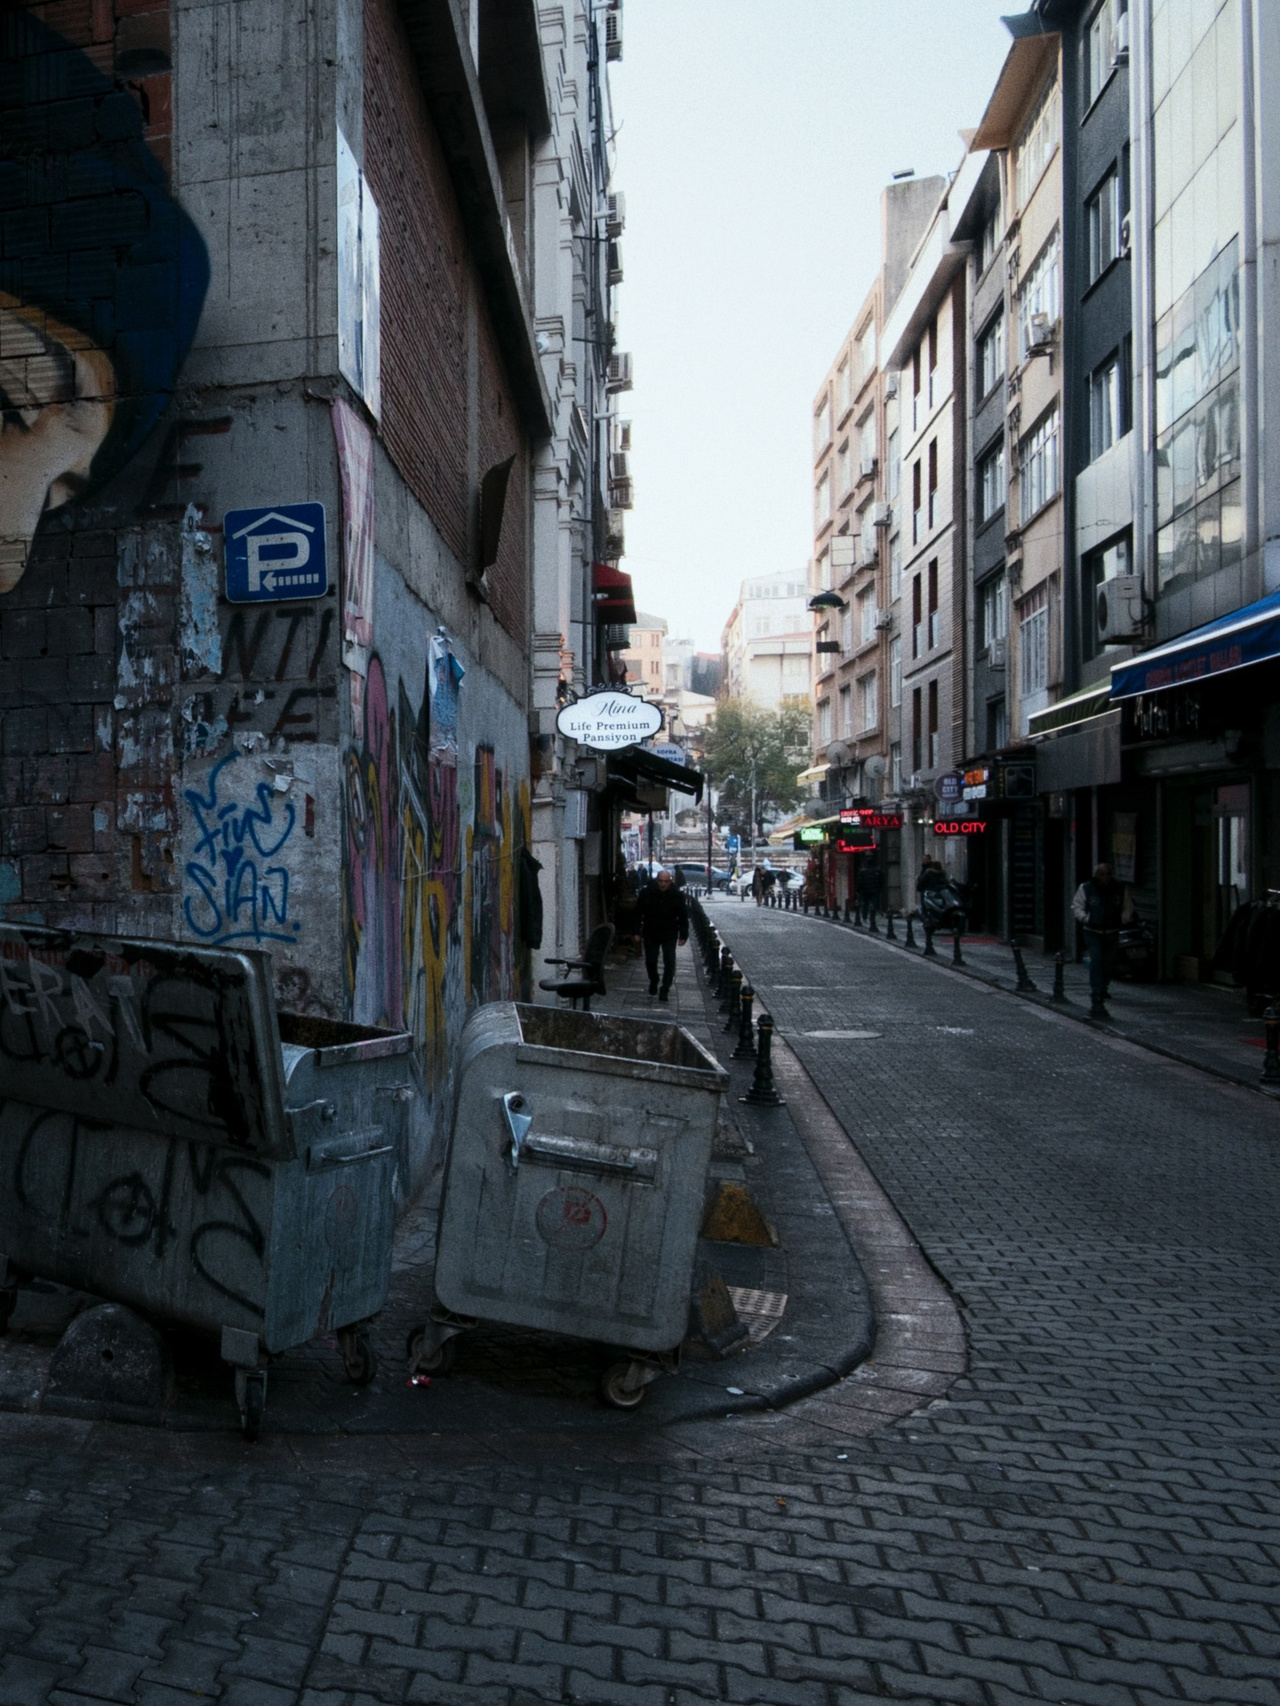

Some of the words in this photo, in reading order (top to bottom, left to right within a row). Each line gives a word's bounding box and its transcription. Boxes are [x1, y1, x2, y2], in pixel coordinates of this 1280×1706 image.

[247, 531, 310, 592] P
[570, 722, 592, 731] Life
[596, 721, 650, 731] Premium
[583, 733, 637, 744] Pansiyon
[865, 816, 900, 826] ARYA
[934, 822, 959, 834] OLD
[961, 821, 987, 834] CITY
